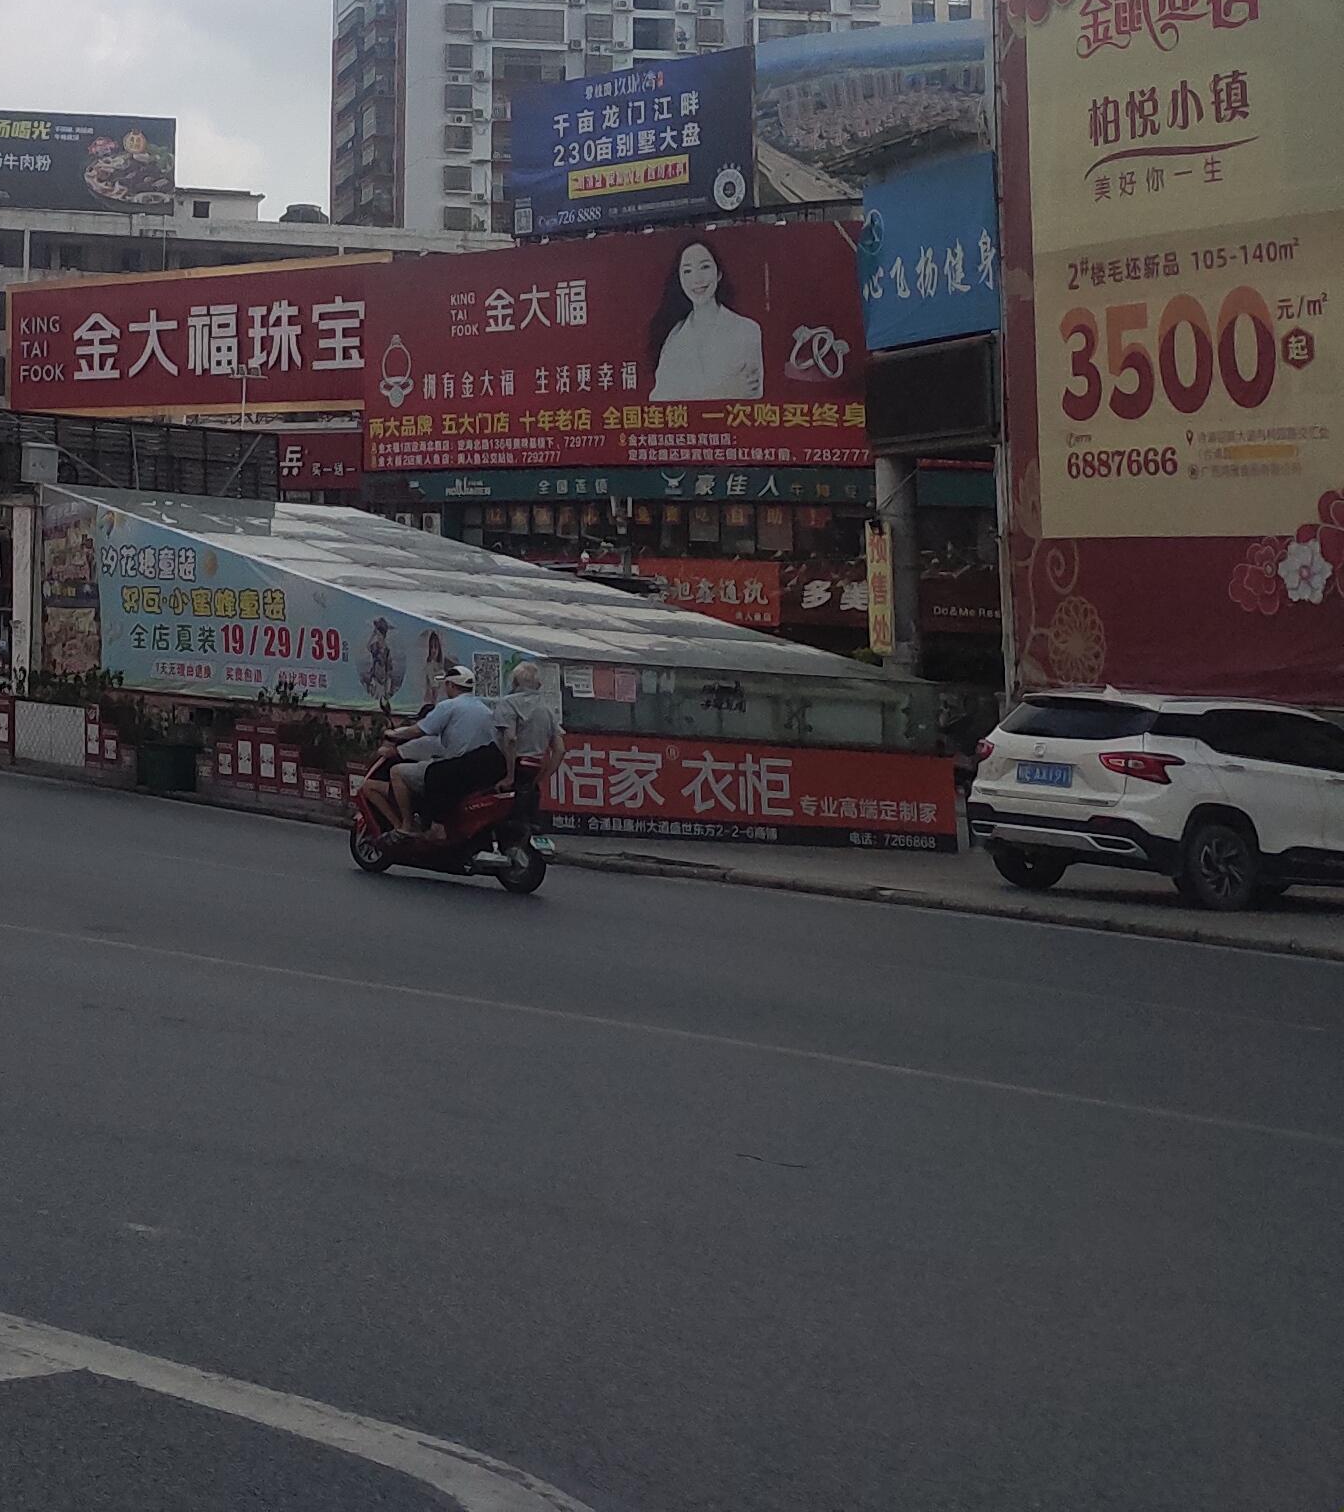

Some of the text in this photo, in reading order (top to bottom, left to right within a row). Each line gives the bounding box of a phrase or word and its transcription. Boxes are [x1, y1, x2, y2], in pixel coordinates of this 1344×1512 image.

[552, 90, 700, 139] 千亩龙门江畔
[1088, 70, 1250, 147] 柏悦小镇
[552, 122, 701, 168] 230亩别墅大盘
[1094, 156, 1223, 202] 美好你一生
[450, 292, 476, 306] KING
[450, 309, 468, 321] TAI
[484, 279, 588, 333] 金大福
[19, 315, 60, 336] KING
[73, 295, 366, 381] 金大福珠宝
[451, 323, 480, 337] FOOK
[20, 341, 48, 359] TAI
[1059, 285, 1277, 422] 3500
[1287, 335, 1309, 361] 起
[19, 363, 65, 383] FOOK
[422, 361, 638, 400] 拥有金大福 生活更幸福
[368, 402, 867, 438] 两大品牌 五大门店 十年老店 全国连锁 一次购买终身
[1066, 445, 1179, 479] 6887666
[694, 472, 781, 497] 豪佳人
[129, 623, 218, 654] 全店夏装
[220, 623, 341, 662] 19/29/39
[681, 749, 794, 817] 衣柜
[799, 794, 938, 825] 专业高端定制家
